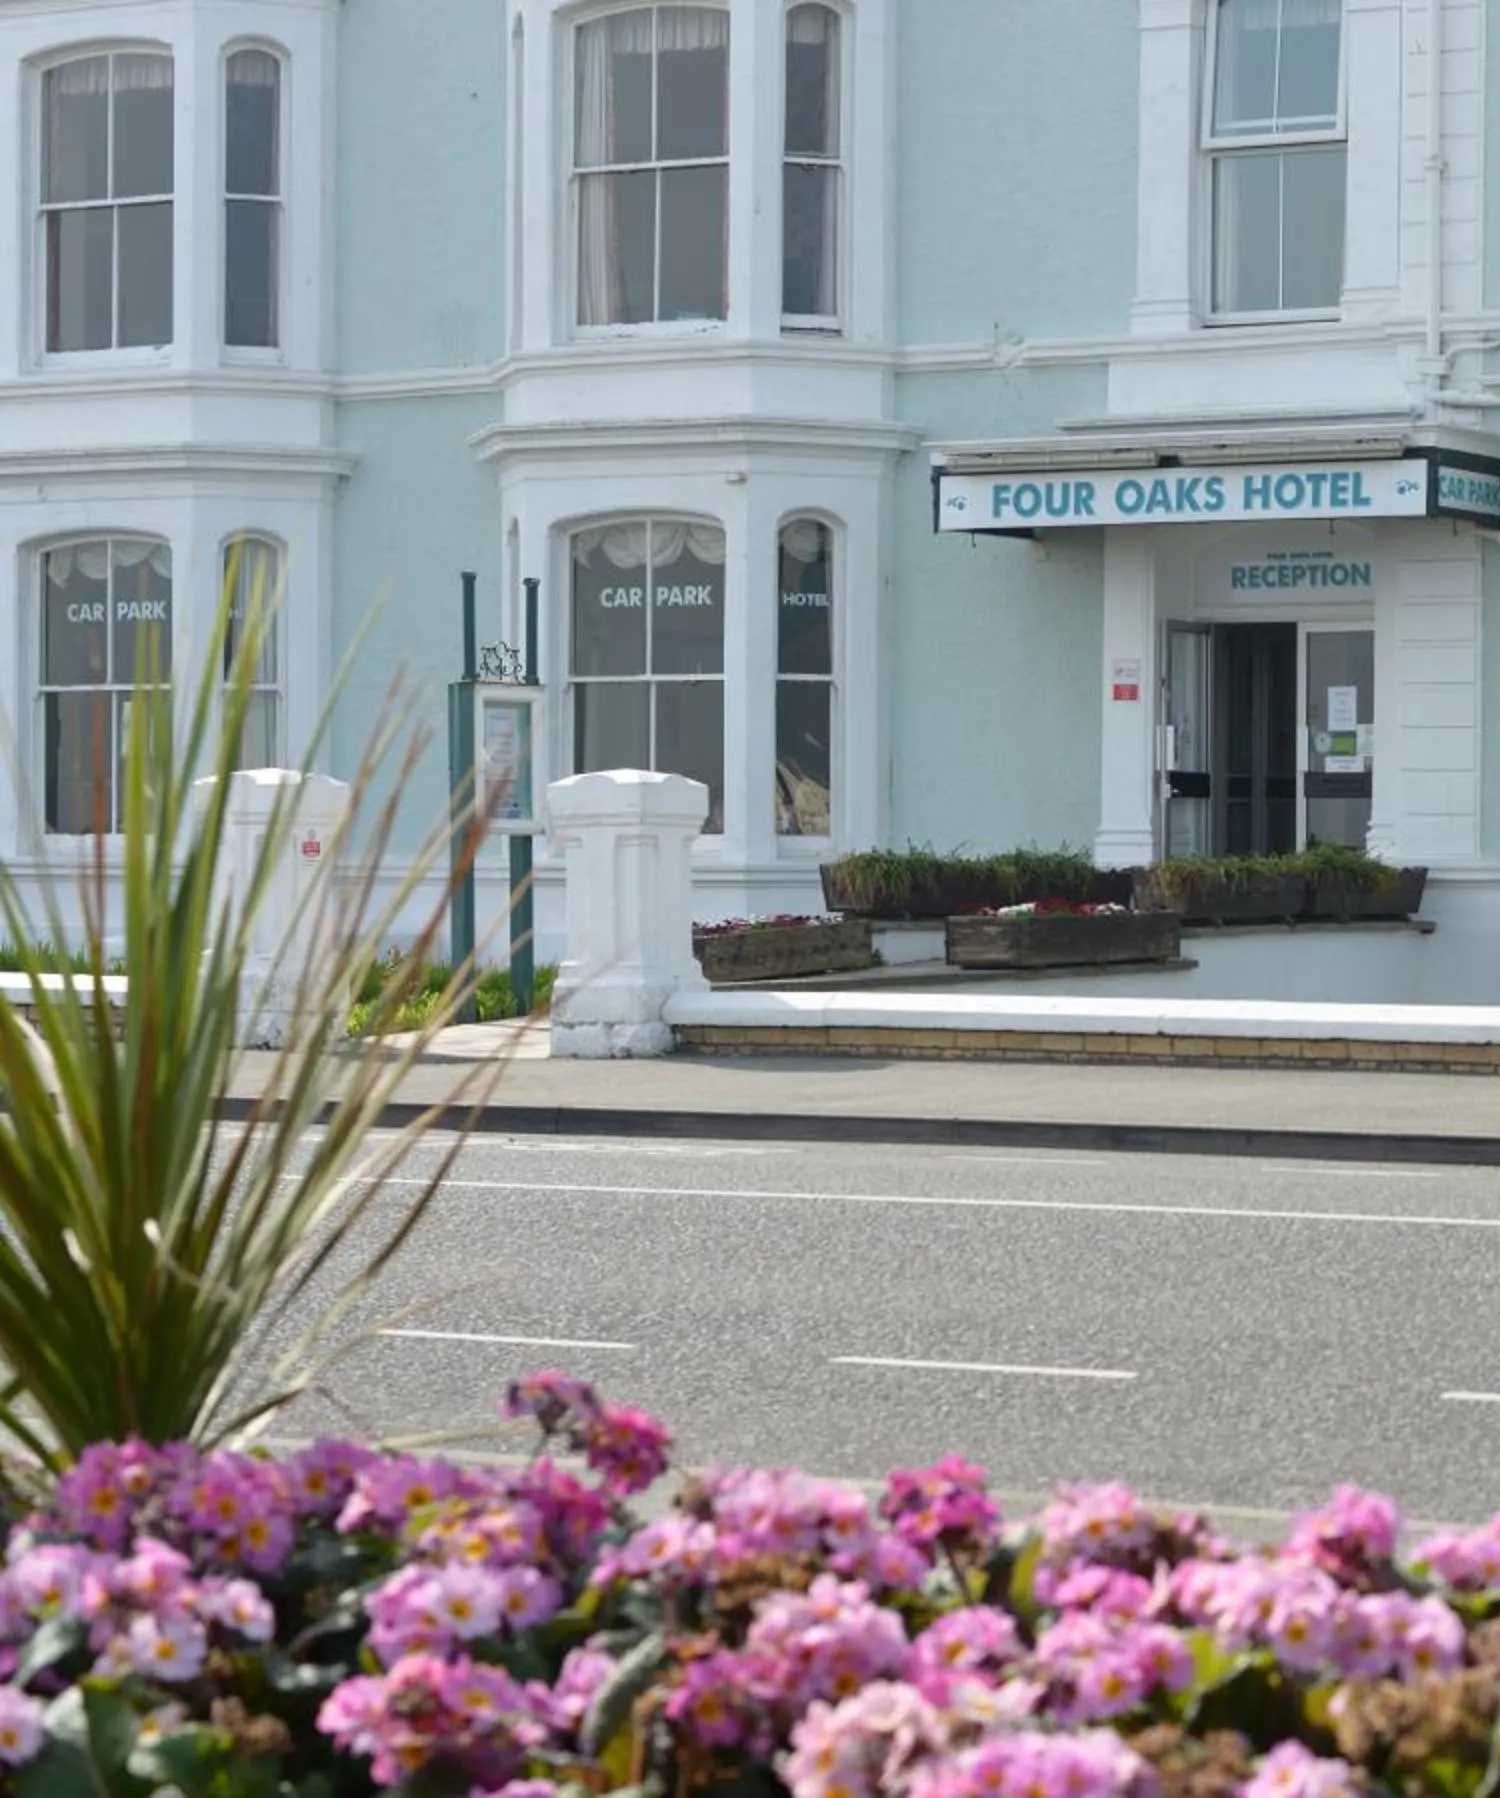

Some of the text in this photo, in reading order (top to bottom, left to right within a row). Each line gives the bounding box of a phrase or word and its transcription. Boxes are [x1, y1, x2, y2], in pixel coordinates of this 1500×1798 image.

[992, 471, 1371, 519] FOUR OAKS HOTEL
[1438, 475, 1465, 501] CAR
[1231, 563, 1371, 589] RECEPTION
[600, 584, 712, 608] CAR PARK
[783, 592, 831, 607] HOTEL
[67, 600, 167, 622] CAR PARK
